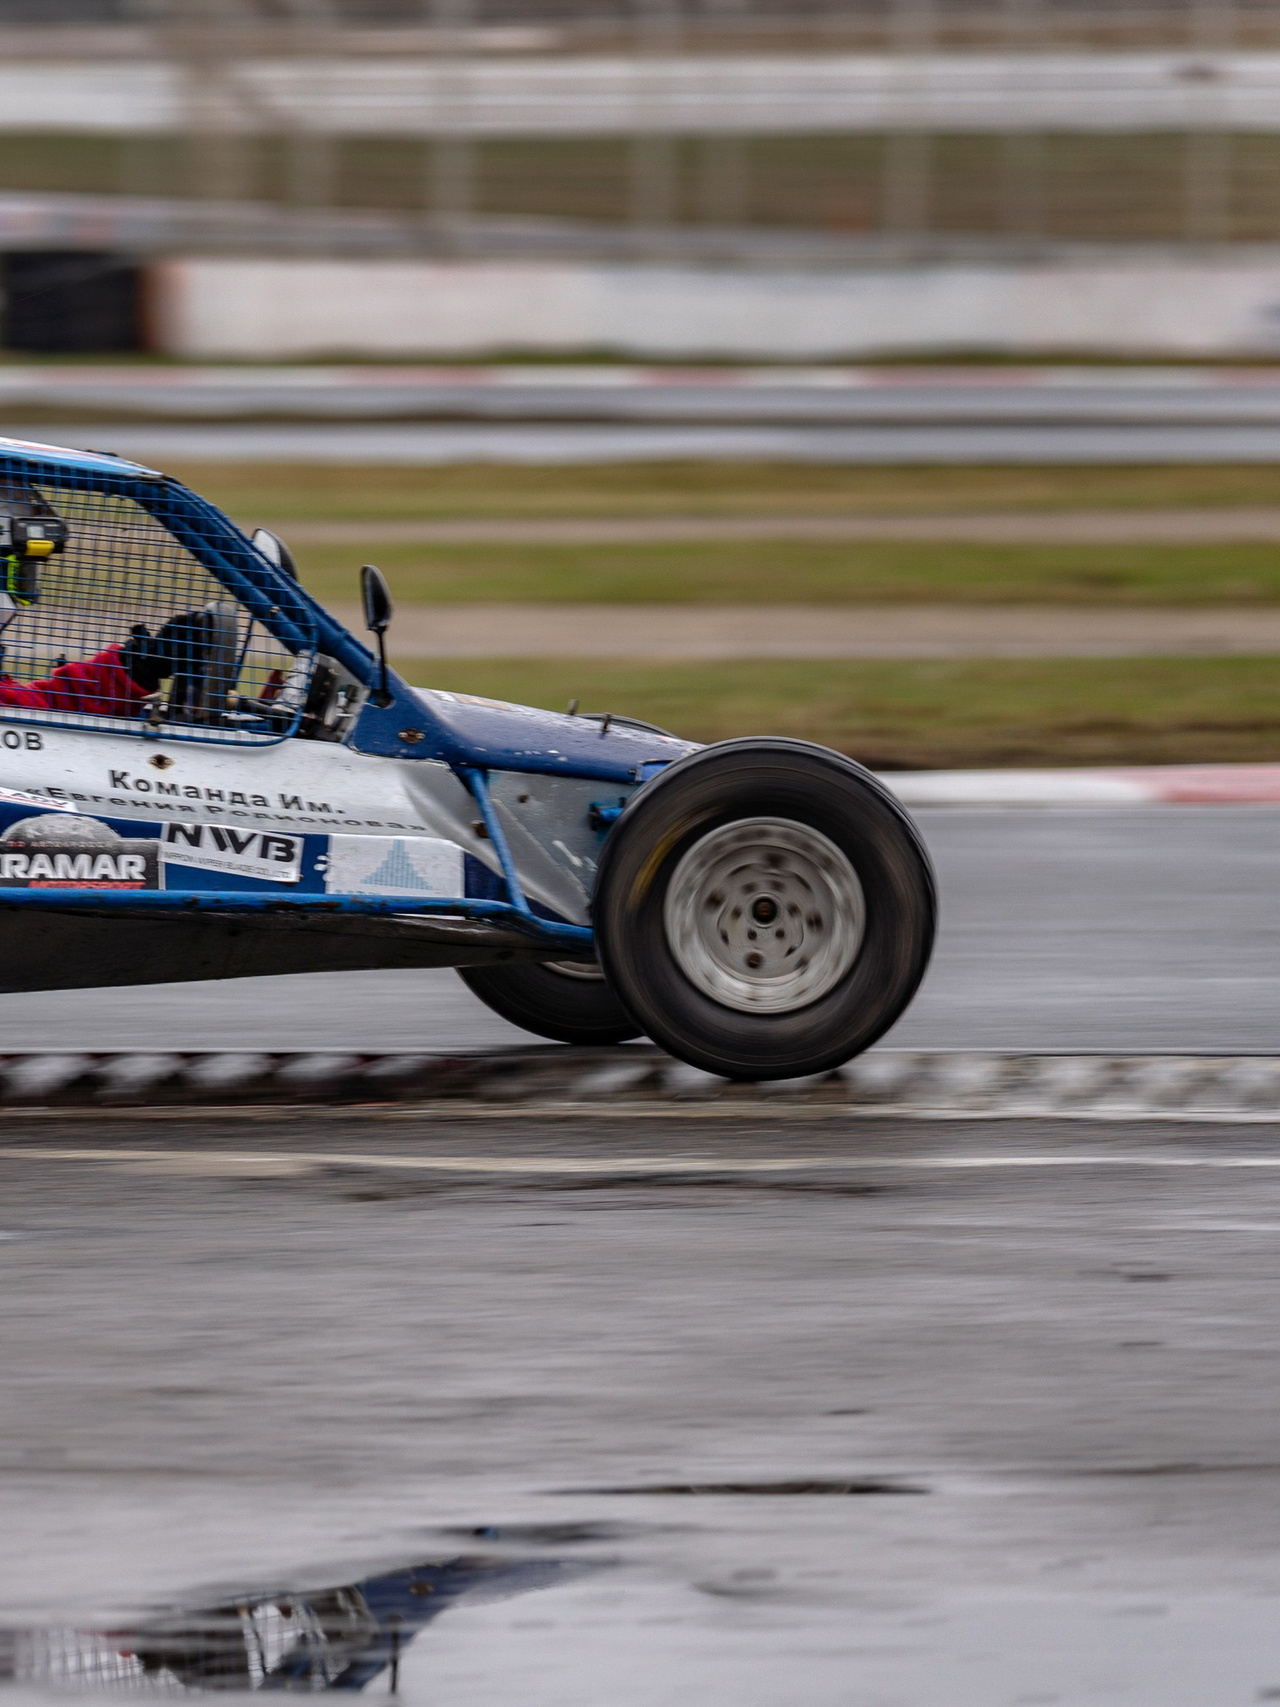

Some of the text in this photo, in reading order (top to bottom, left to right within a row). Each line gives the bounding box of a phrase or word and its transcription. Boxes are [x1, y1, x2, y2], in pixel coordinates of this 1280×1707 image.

[108, 769, 346, 814] Команда Им.
[166, 822, 296, 863] NWB
